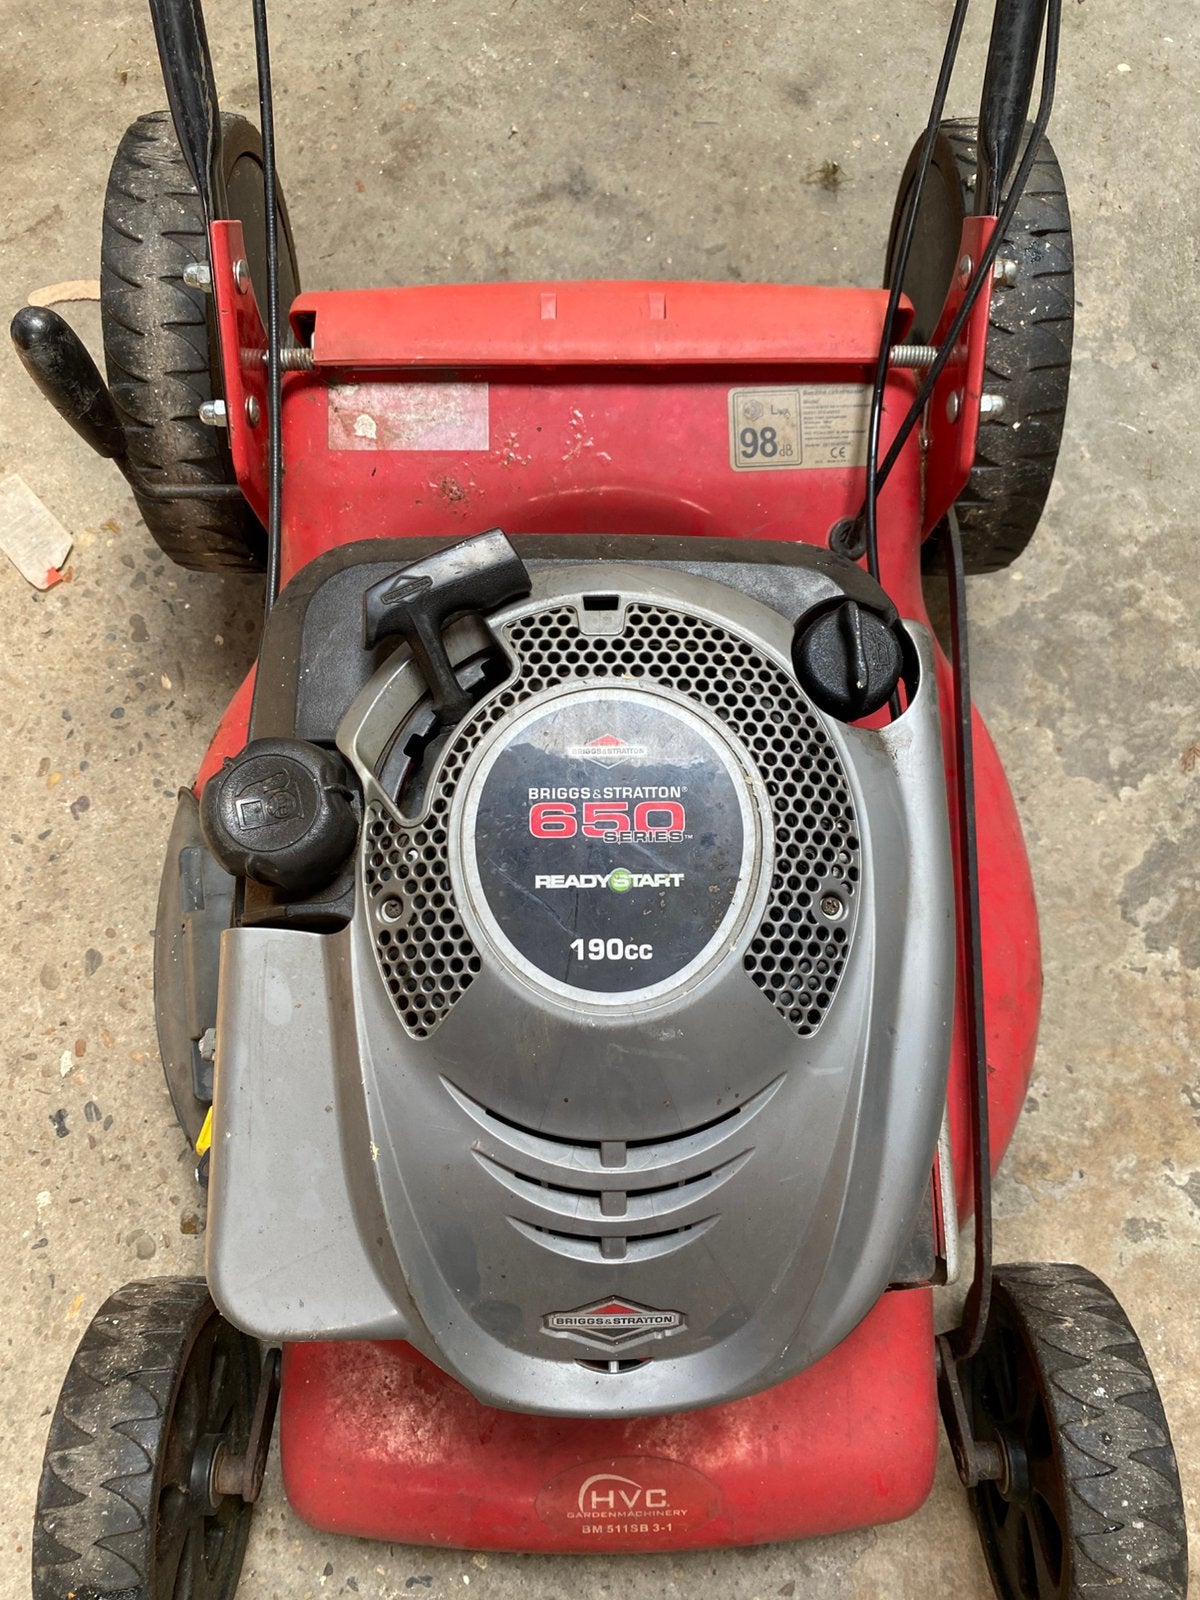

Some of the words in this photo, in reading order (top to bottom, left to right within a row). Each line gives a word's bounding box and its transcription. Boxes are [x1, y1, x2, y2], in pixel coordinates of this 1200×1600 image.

[740, 426, 778, 459] 98
[779, 444, 794, 457] dB
[830, 446, 846, 459] CE
[528, 800, 686, 839] 650
[569, 938, 653, 961] 190cc
[566, 1509, 688, 1520] GARDENMACHINERY
[582, 1524, 603, 1534] BM
[606, 1523, 649, 1534] 511SB
[652, 1522, 673, 1533] 3-1
